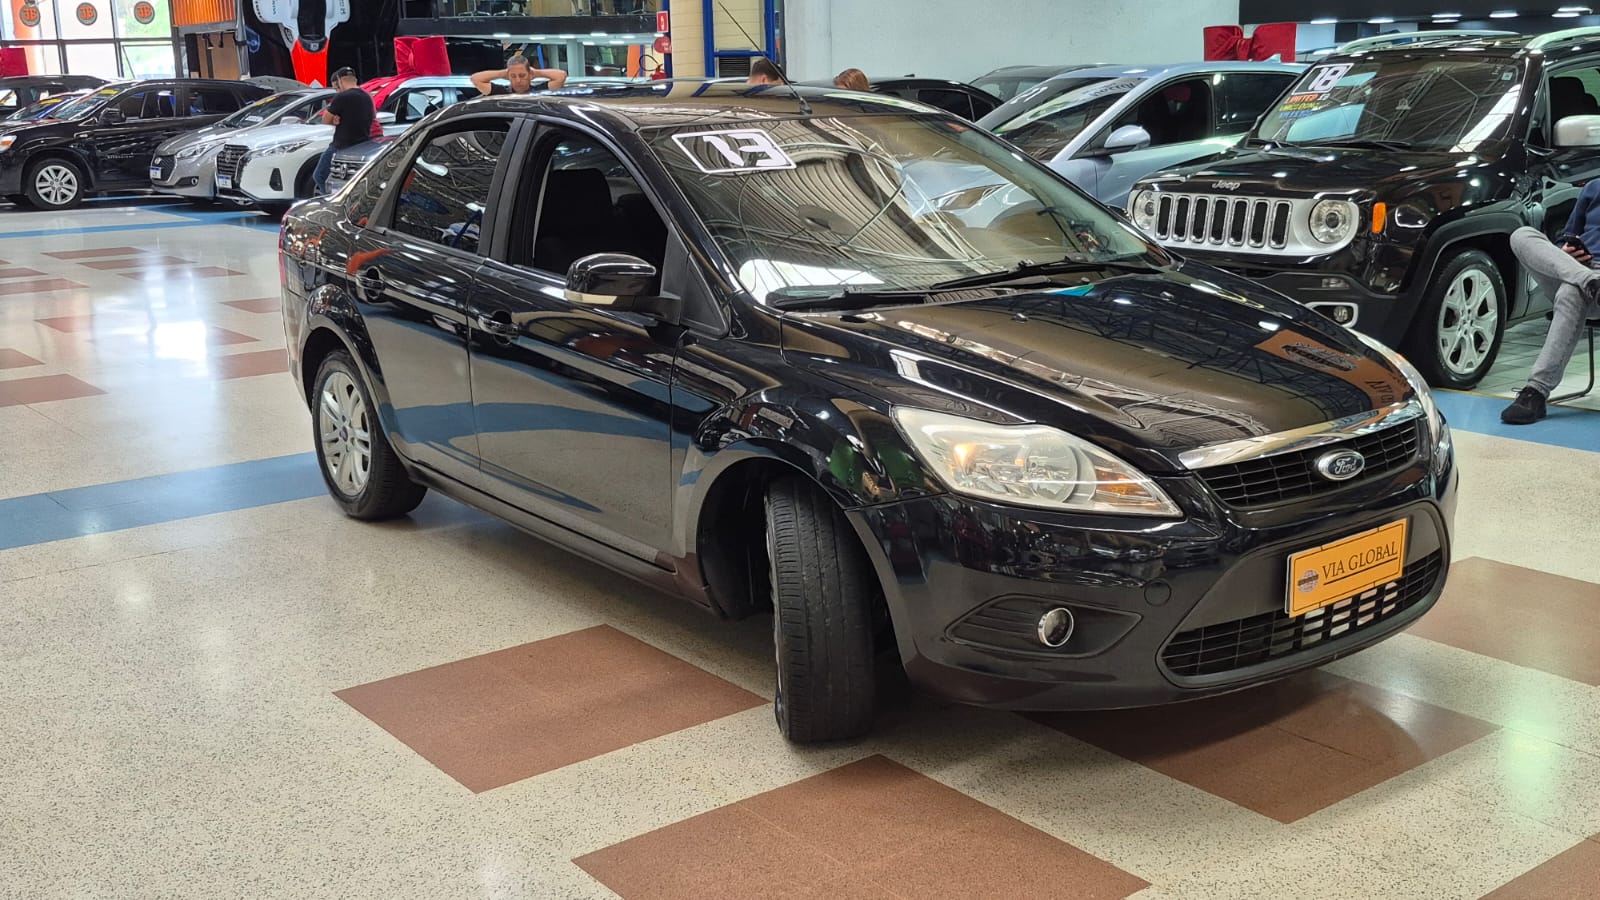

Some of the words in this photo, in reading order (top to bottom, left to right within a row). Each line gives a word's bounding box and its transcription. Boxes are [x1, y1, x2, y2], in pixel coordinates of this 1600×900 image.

[1308, 66, 1347, 91] 18
[702, 132, 788, 167] 13
[1211, 180, 1241, 191] Jeep
[1334, 457, 1357, 475] Ford
[1322, 559, 1345, 580] VIA
[1348, 541, 1398, 571] GLOBAL
